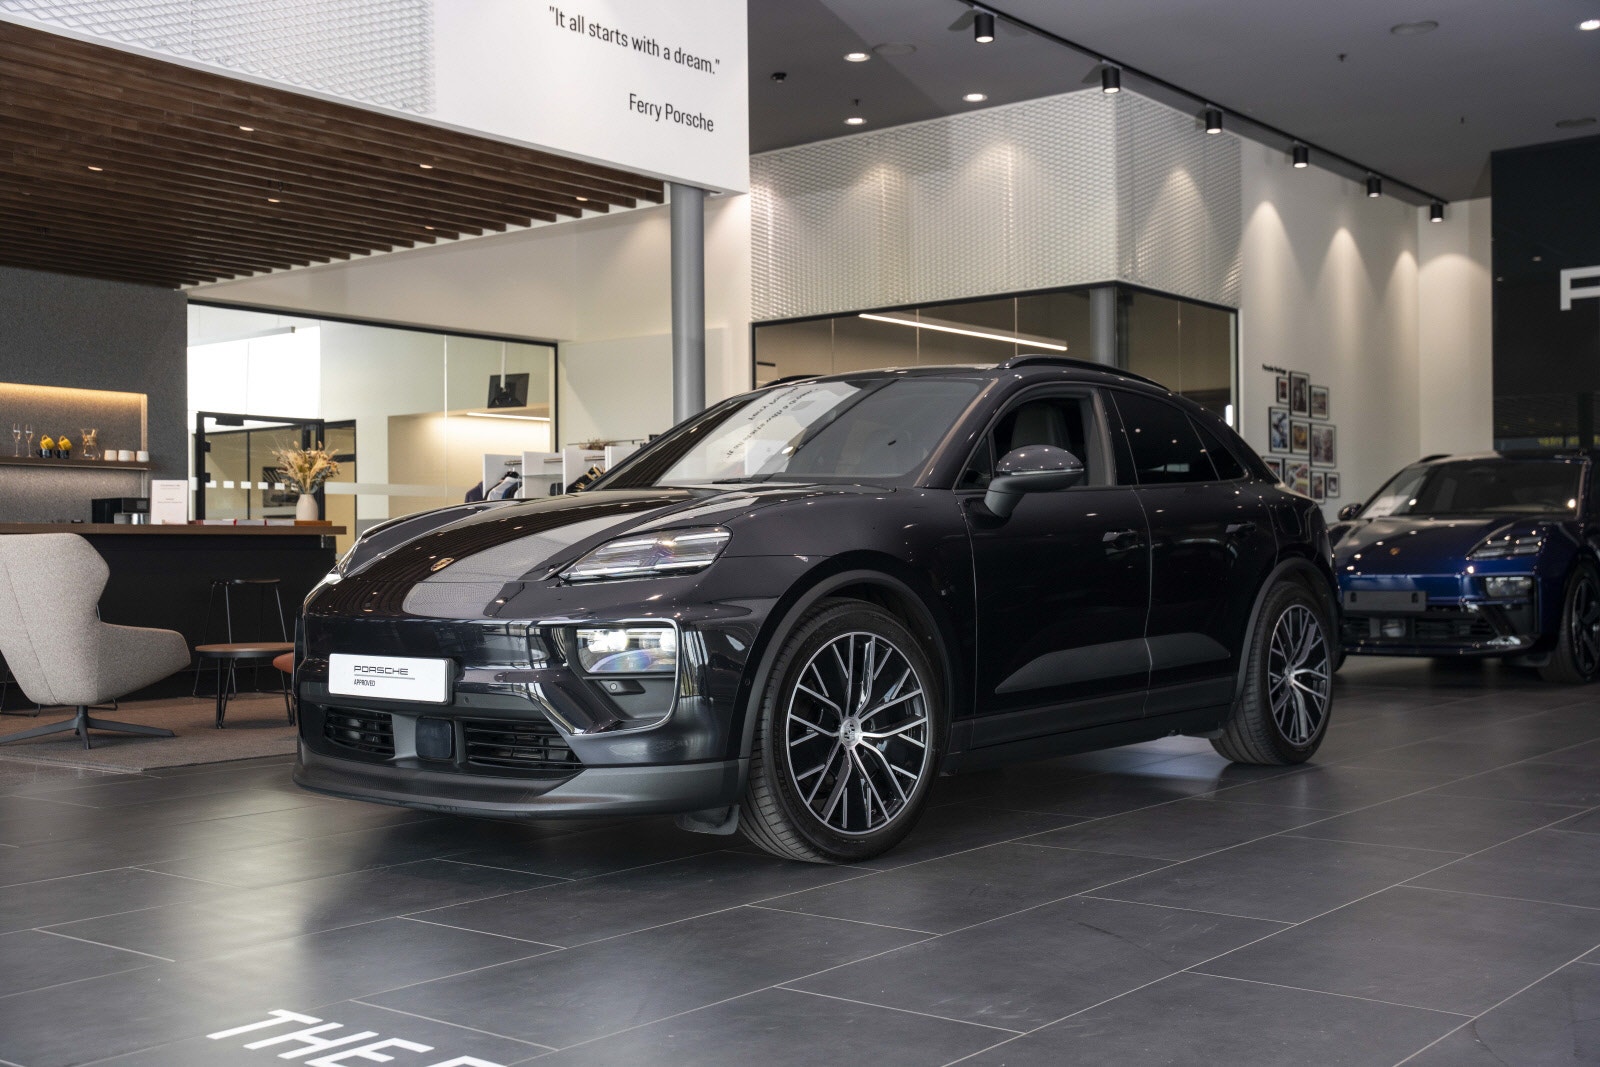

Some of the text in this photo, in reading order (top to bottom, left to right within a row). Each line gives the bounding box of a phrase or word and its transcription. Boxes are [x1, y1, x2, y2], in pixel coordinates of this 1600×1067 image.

[549, 6, 720, 75] "It all starts with a dream."
[629, 92, 714, 132] Ferry Porsche
[353, 665, 409, 676] PORSCHE
[353, 679, 376, 687] APPROVED
[206, 1008, 435, 1067] THE
